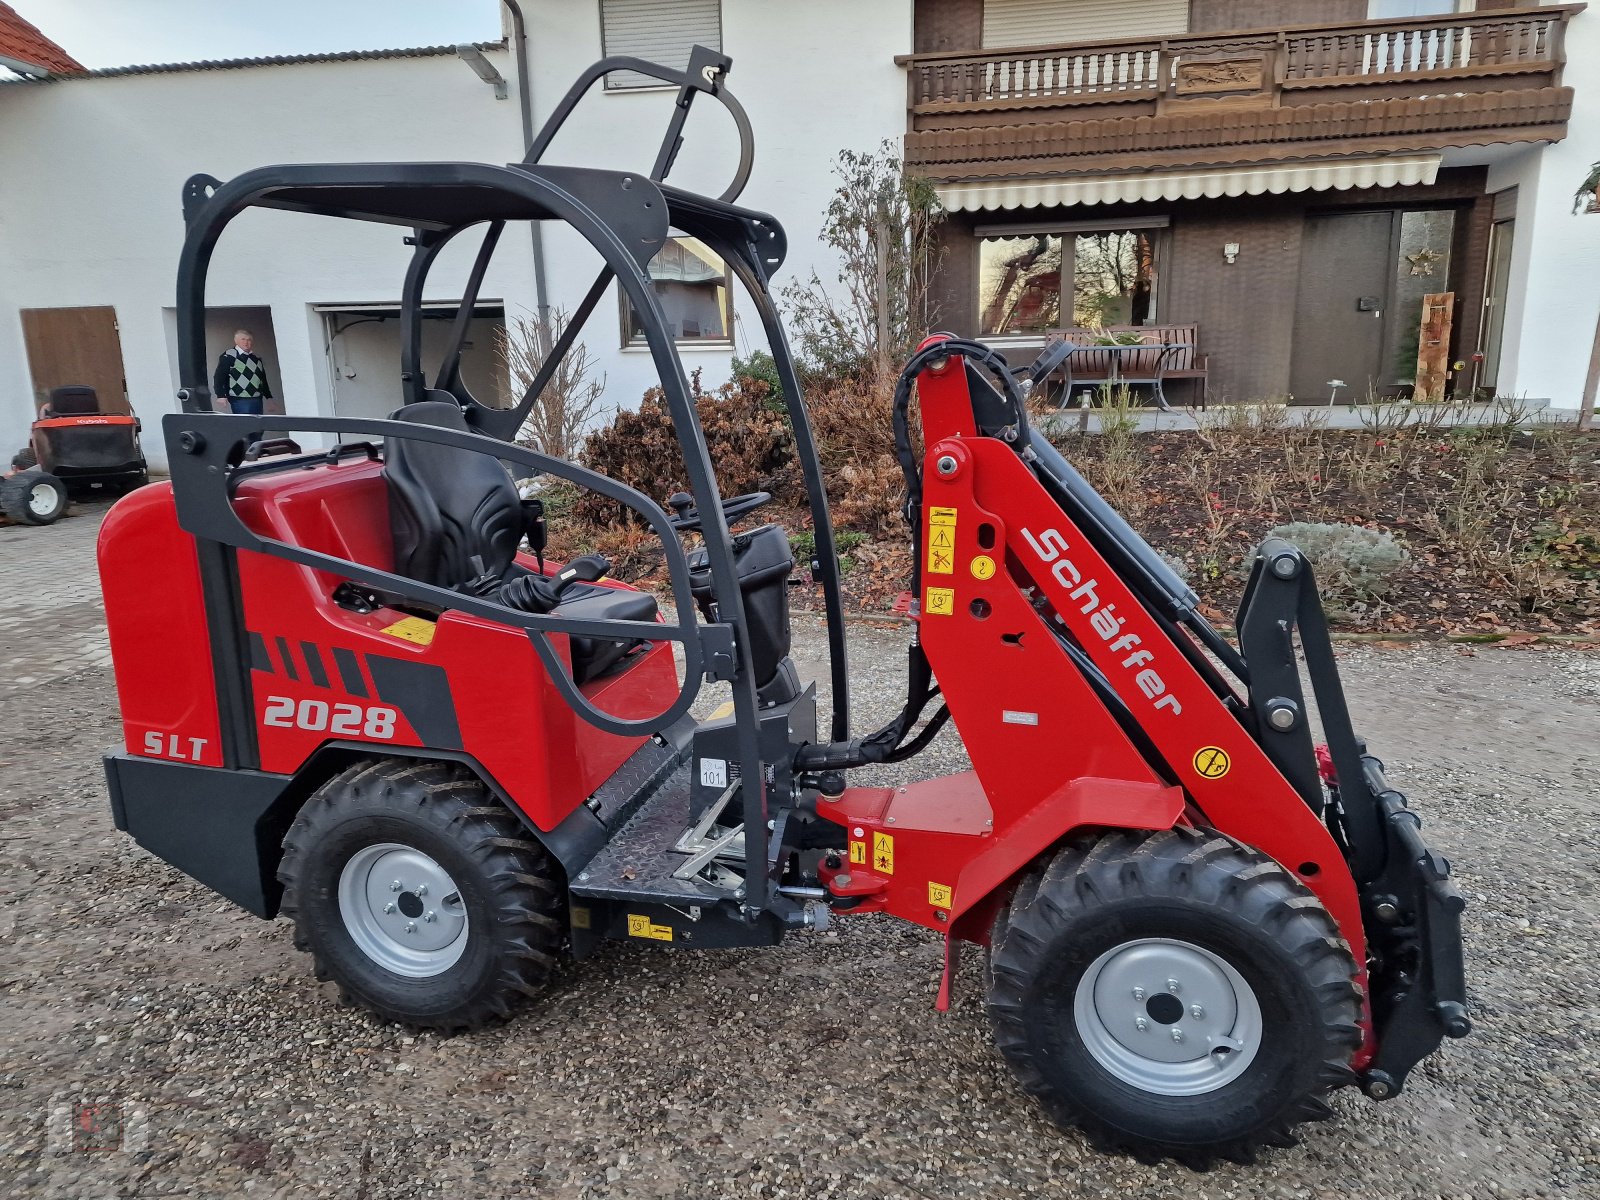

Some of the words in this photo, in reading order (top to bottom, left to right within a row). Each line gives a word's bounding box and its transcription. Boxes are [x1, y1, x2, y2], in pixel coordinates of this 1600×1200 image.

[1020, 527, 1182, 716] Schäffer
[263, 695, 397, 739] 2028
[144, 731, 208, 761] SLT
[703, 771, 719, 785] 101
